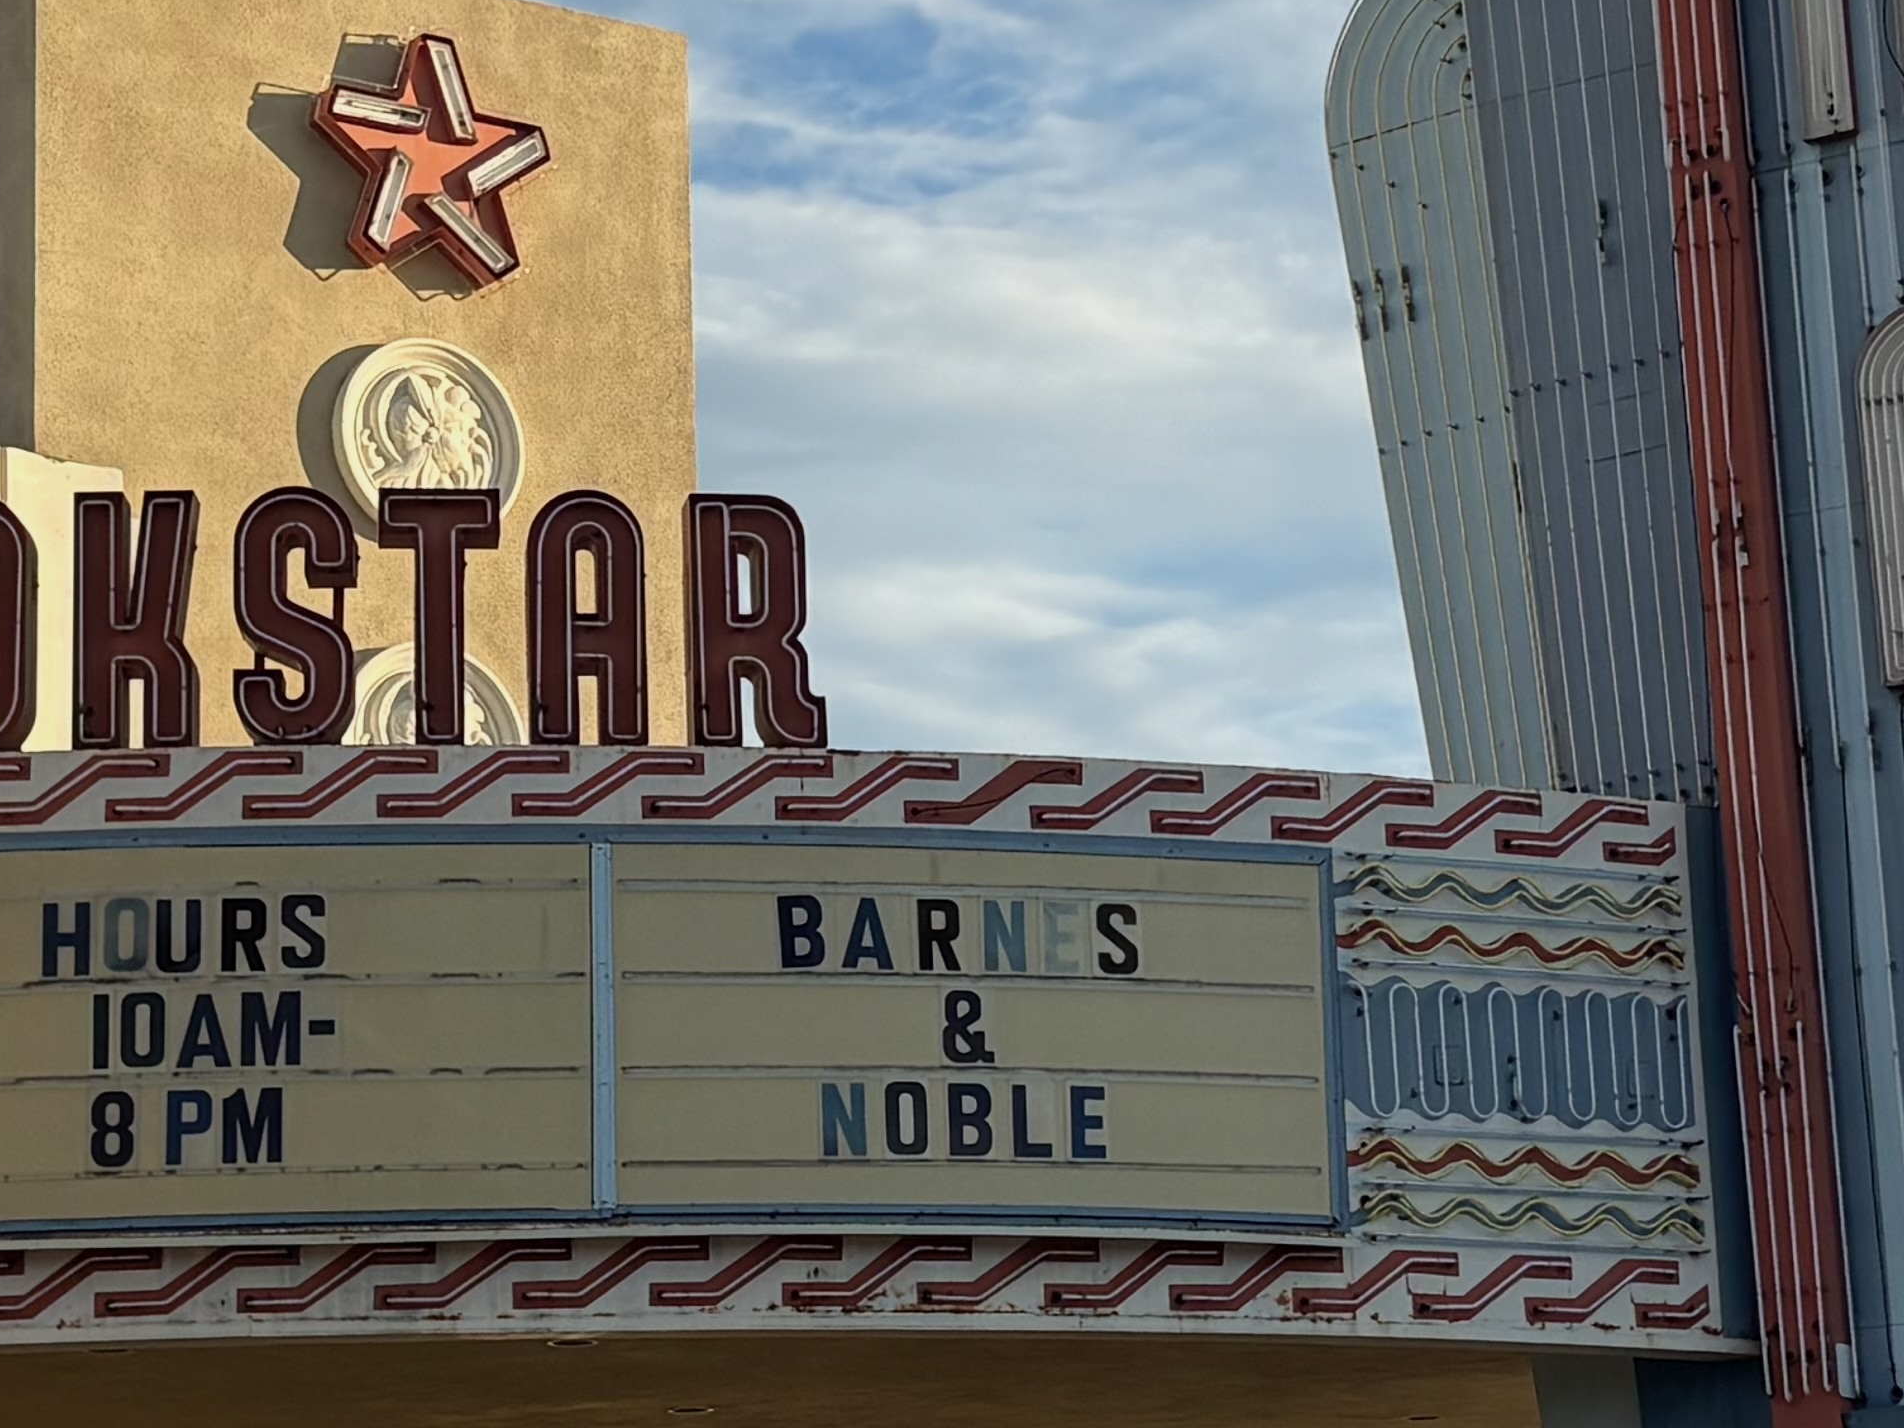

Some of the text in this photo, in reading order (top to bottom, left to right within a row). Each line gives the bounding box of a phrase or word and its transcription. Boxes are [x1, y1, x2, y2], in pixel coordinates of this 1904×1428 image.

[42, 894, 326, 977] HOURS
[777, 894, 1139, 974] BARNES
[942, 990, 995, 1063] &
[91, 1087, 282, 1167] 8 PM
[821, 1081, 1107, 1159] NOBLE
